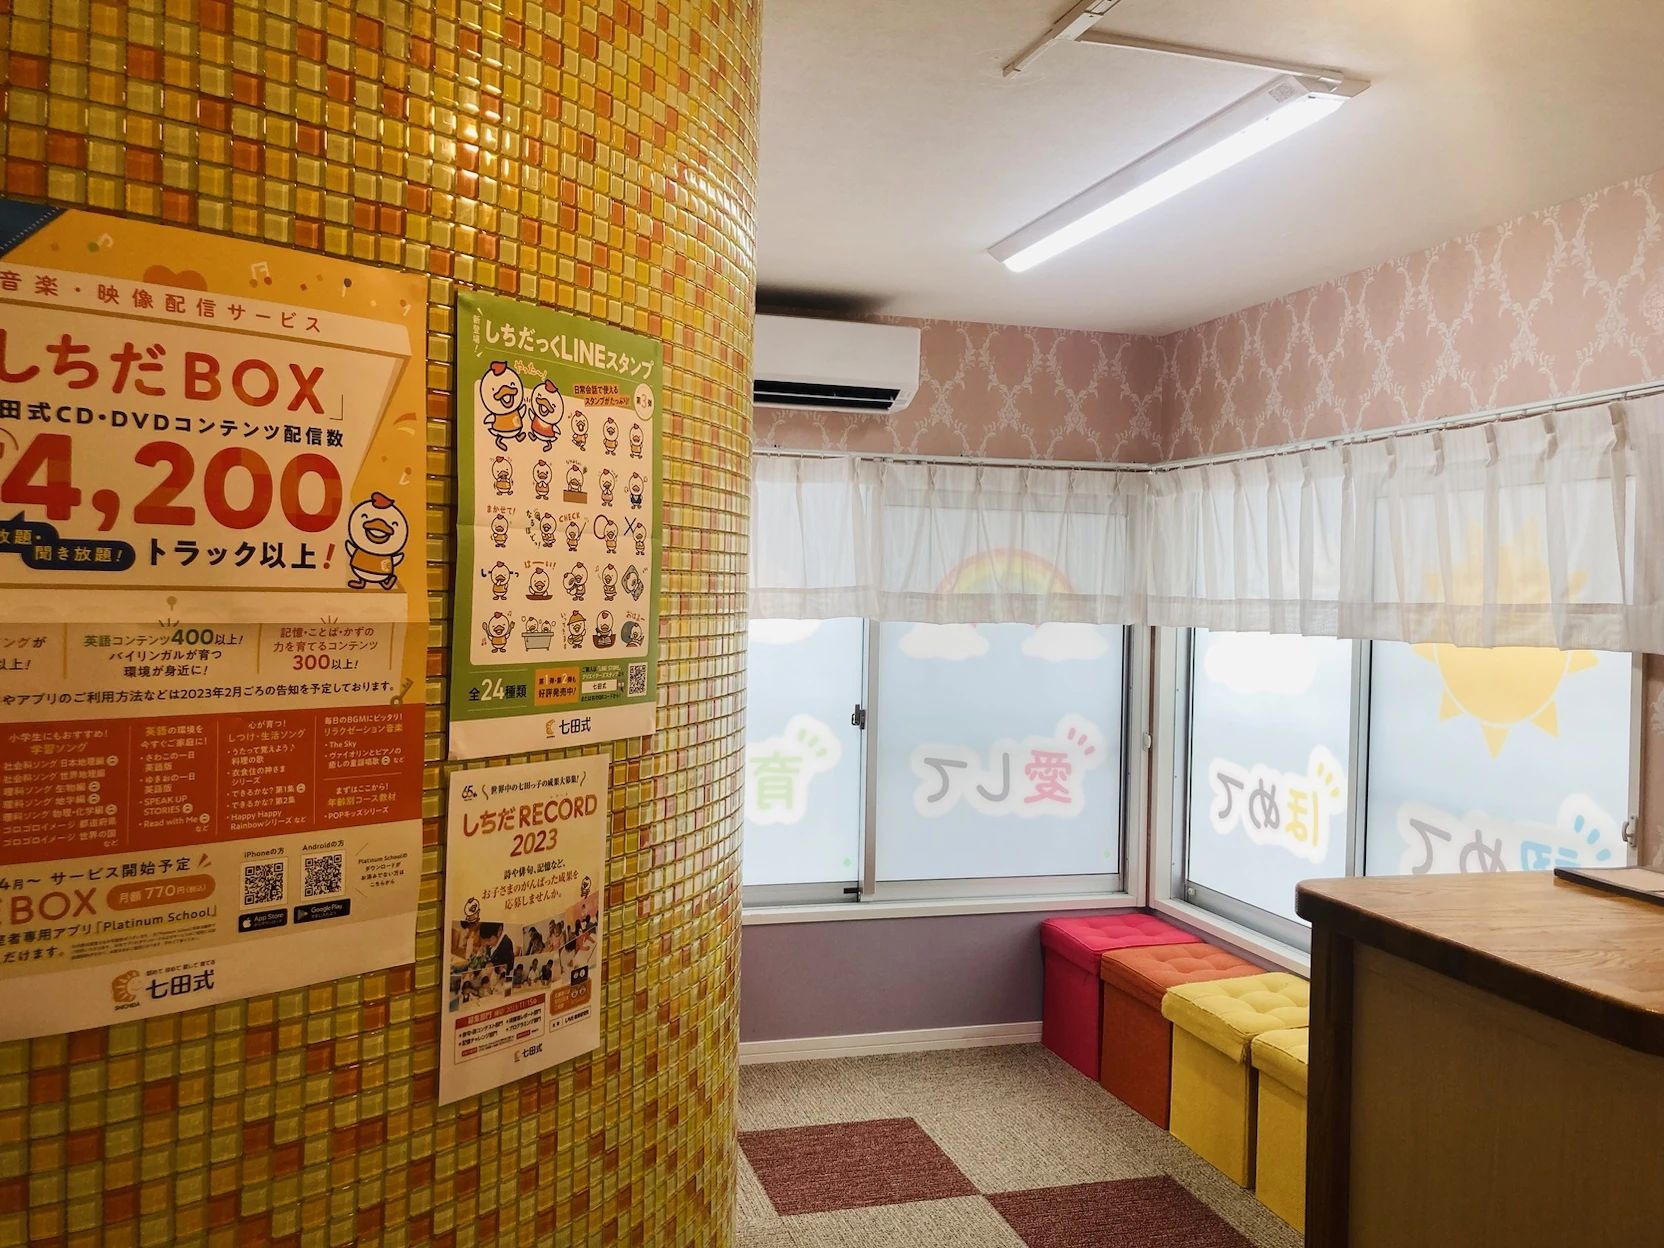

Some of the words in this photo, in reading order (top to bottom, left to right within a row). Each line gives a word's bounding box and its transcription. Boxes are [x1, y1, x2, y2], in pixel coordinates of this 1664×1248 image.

[0, 270, 321, 333] 音楽・映像配信サービス
[484, 319, 655, 380] しちだっくLINEスタンプ
[1, 432, 343, 534] 4,200
[558, 512, 581, 523] CHECK
[149, 538, 336, 570] トラック以上!
[84, 629, 243, 648] 英語コンテンツ400以上!
[273, 640, 378, 653] 力を育てるコンテンツ
[109, 649, 222, 662] バイリンガルが育つ
[292, 653, 359, 671] 300以上!
[123, 665, 208, 678] 環境が身近に!
[468, 677, 527, 702] 全24種類
[558, 717, 591, 735] 七田式
[343, 740, 357, 748] Sky
[144, 796, 174, 806] SPEAK
[175, 795, 188, 803] UP
[143, 805, 181, 816] STORIES
[231, 812, 256, 821] Happy
[257, 810, 282, 819] Happy
[302, 840, 344, 851] Androidの方
[510, 828, 558, 857] 2023
[244, 847, 285, 858] iPhoneの方
[51, 857, 191, 885] サービス開始予定
[311, 905, 332, 914] Google
[330, 903, 343, 912] Play
[254, 914, 267, 922] App
[268, 911, 284, 920] Store
[145, 969, 215, 999] 七田式
